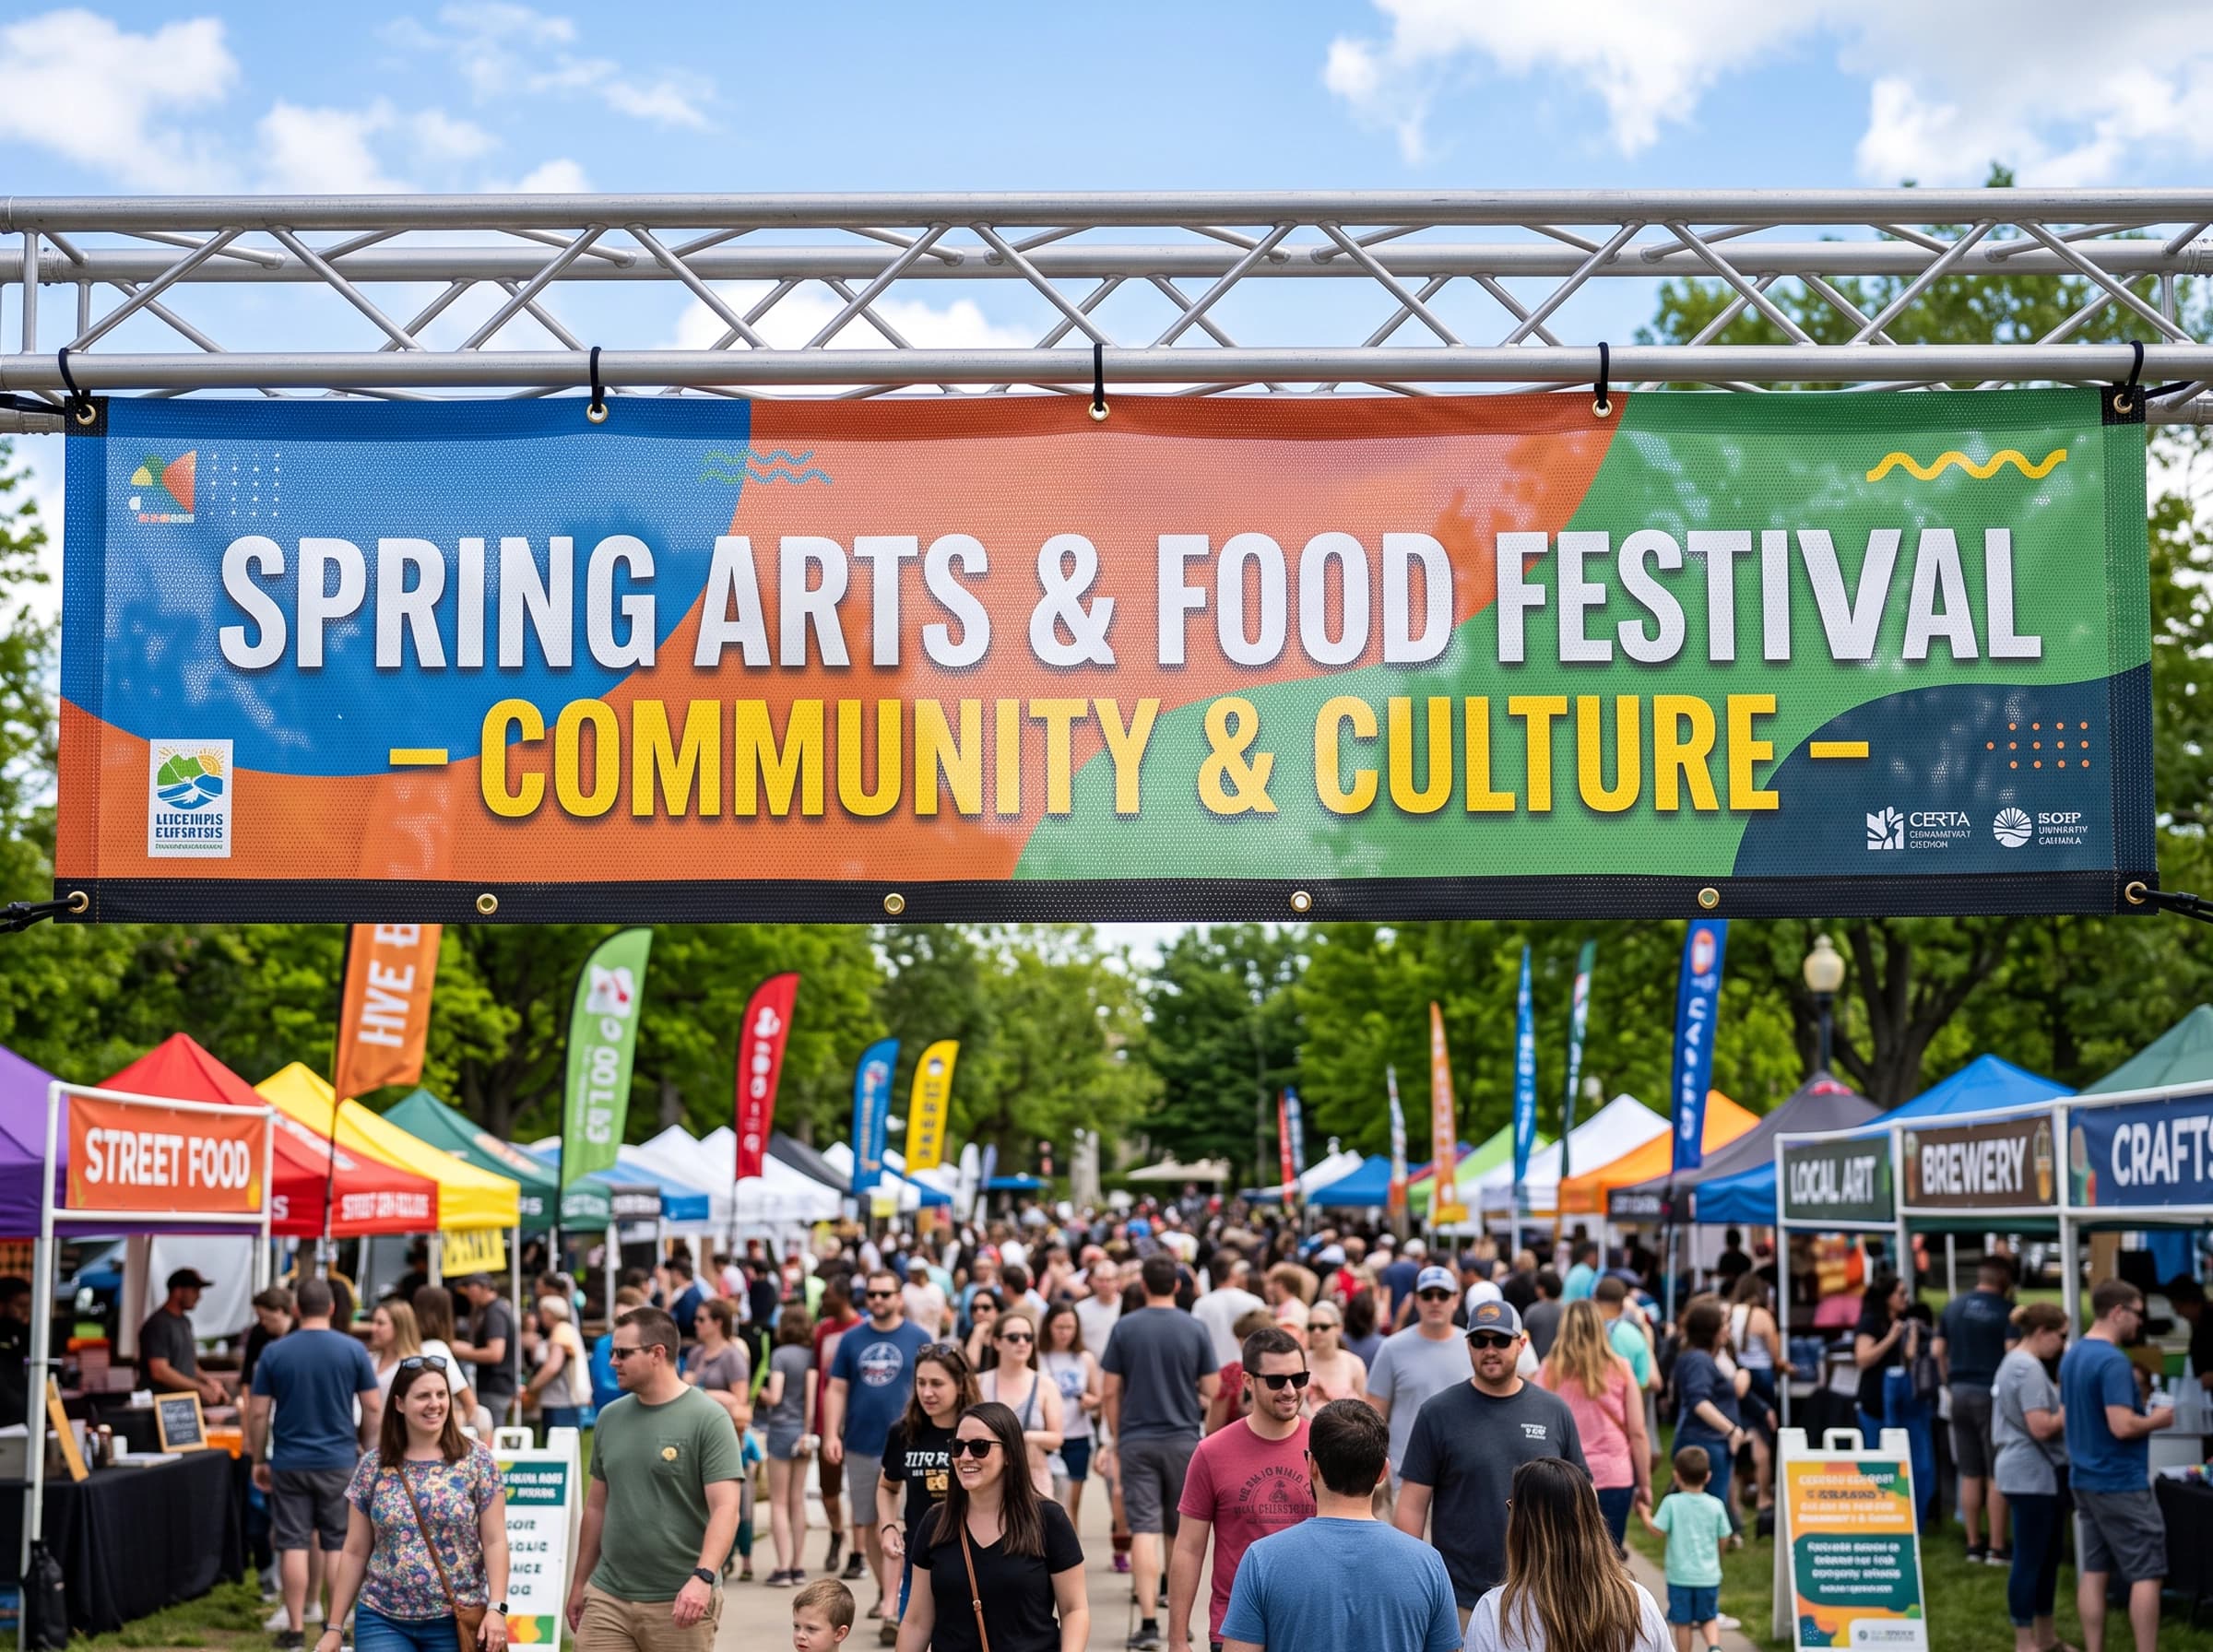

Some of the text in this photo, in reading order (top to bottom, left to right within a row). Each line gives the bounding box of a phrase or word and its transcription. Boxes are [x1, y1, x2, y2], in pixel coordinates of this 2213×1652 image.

[219, 528, 2042, 669] SPRING ARTS & FOOD FESTIVAL
[480, 697, 1161, 819] COMMUNITY
[1198, 697, 1279, 815] &
[1315, 693, 1780, 815] CULTURE
[1910, 811, 1970, 827] CERTA
[85, 1127, 184, 1187] STREET
[188, 1136, 251, 1189] FOOD
[1790, 1155, 1876, 1205] LOCAL ART
[1921, 1136, 2028, 1195] BREWERY
